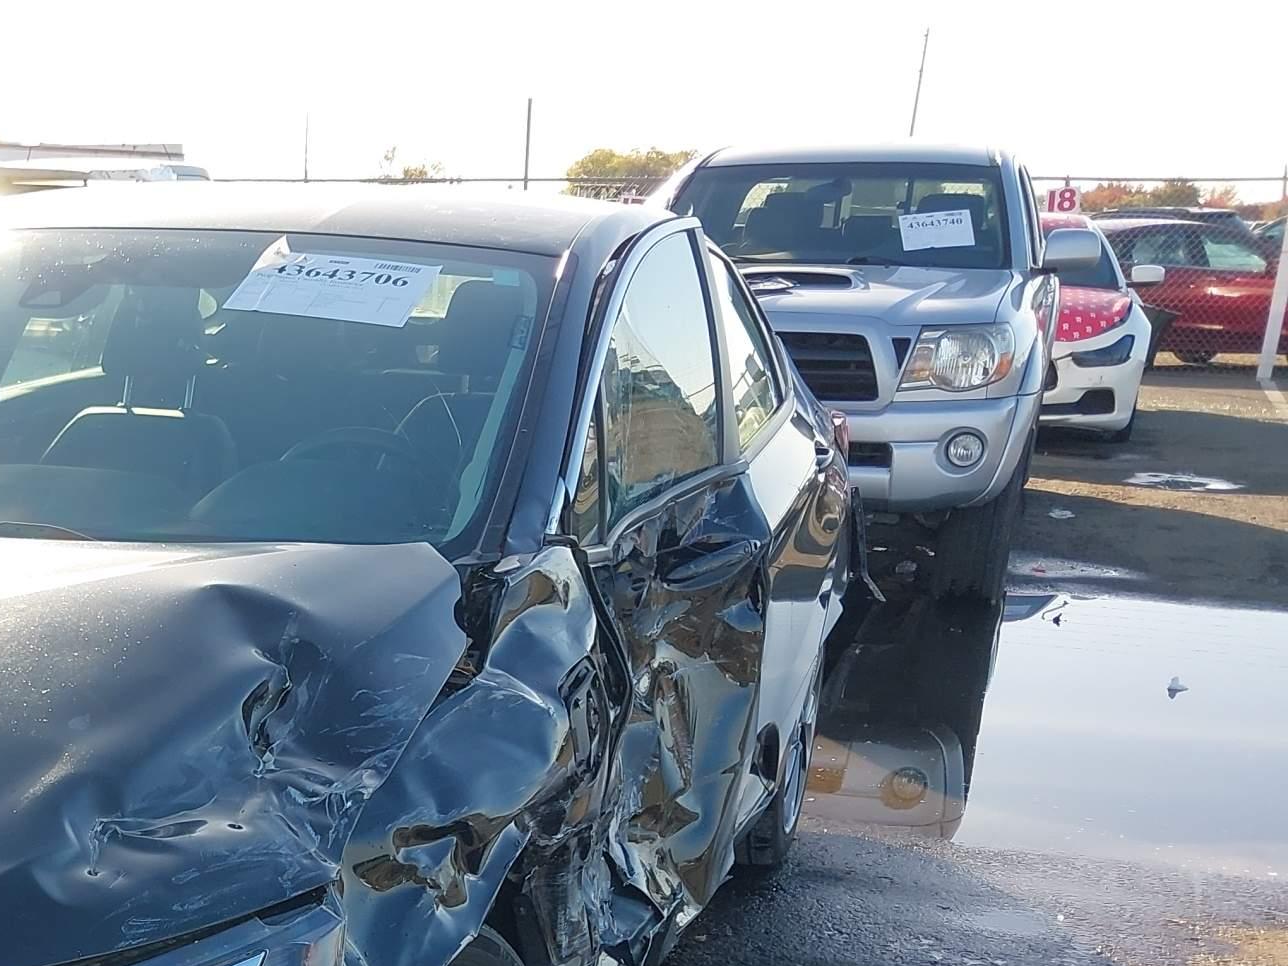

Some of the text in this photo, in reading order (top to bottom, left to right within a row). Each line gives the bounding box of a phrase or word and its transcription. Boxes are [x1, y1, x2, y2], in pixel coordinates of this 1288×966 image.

[1047, 188, 1076, 212] 18
[907, 217, 963, 229] 43643740
[274, 264, 409, 287] 43643706
